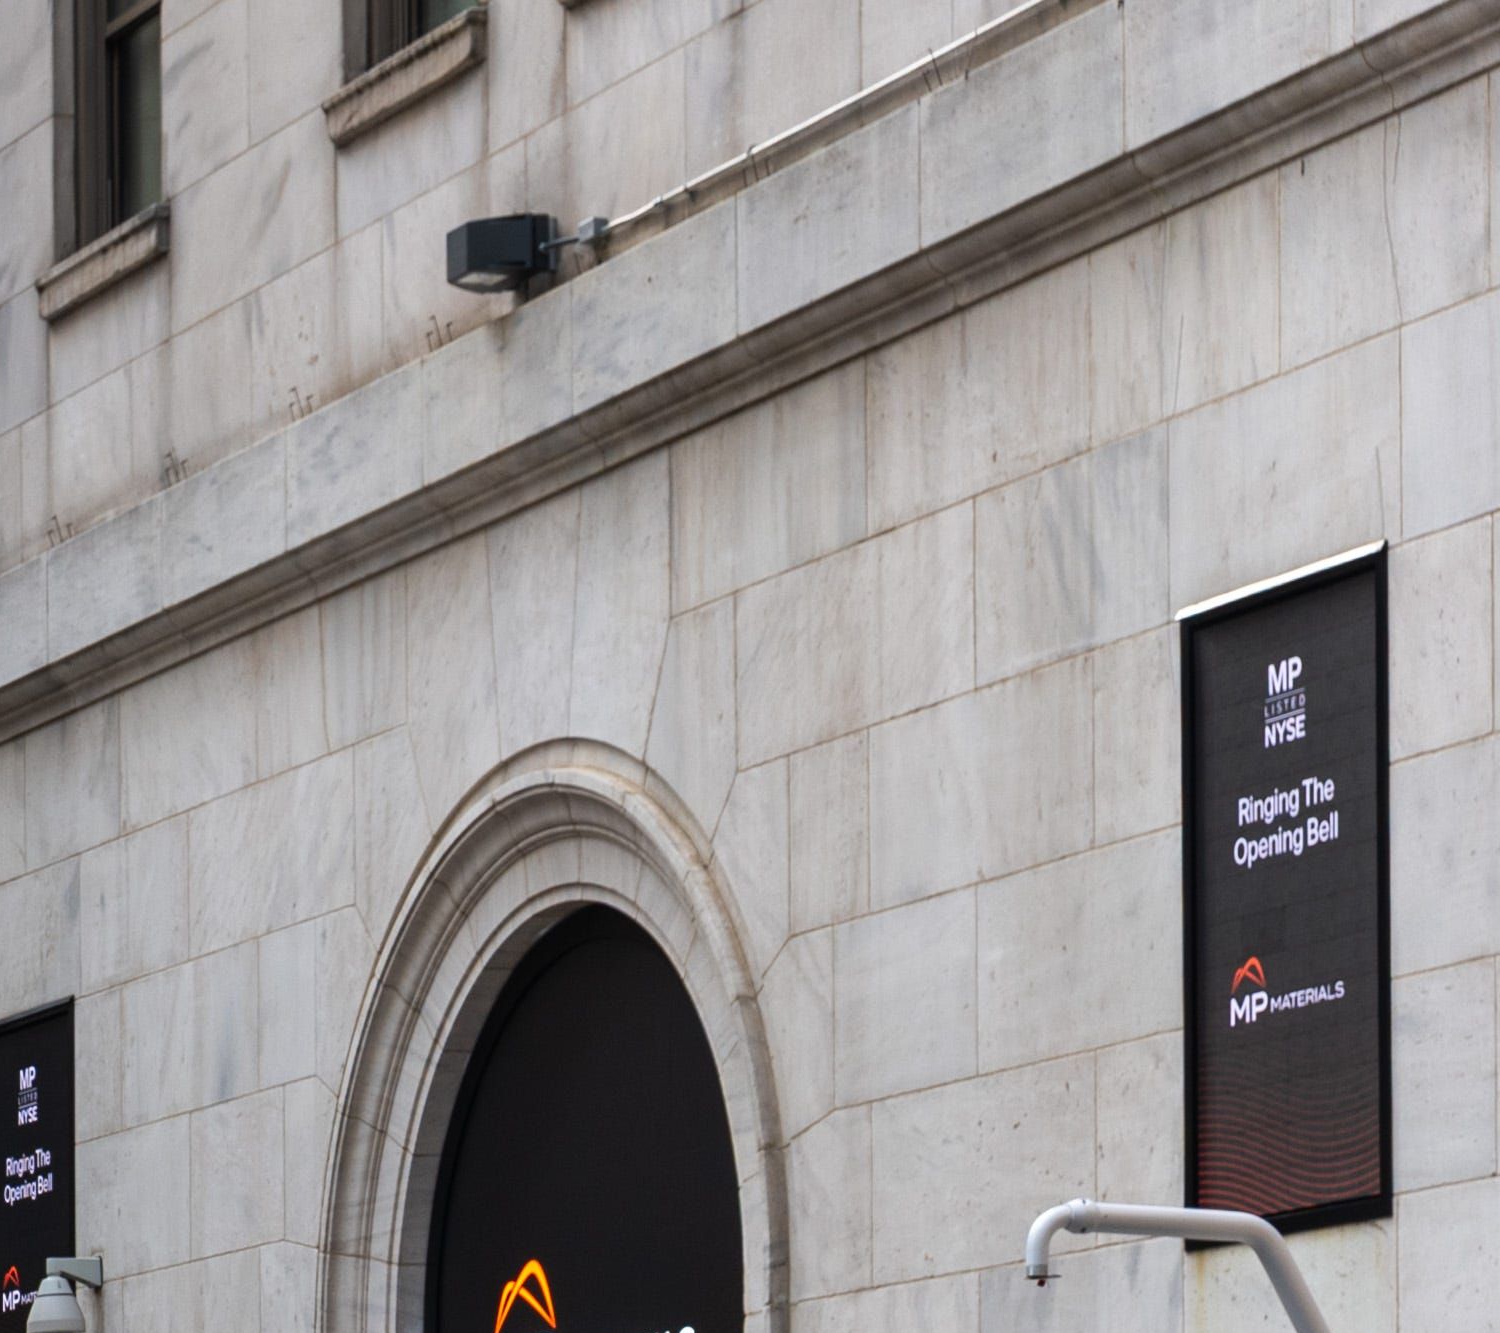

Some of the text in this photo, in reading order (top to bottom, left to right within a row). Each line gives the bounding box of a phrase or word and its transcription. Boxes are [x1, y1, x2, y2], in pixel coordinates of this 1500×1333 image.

[1267, 655, 1303, 697] MP
[1263, 692, 1307, 718] LISTED
[1263, 713, 1307, 748] NYSE
[1237, 775, 1336, 827] Ringing The
[1233, 809, 1340, 870] Opening Bell
[1229, 979, 1346, 1028] MP MATERIALS
[18, 1065, 37, 1092] MP
[17, 1105, 38, 1127] NYSE
[5, 1147, 52, 1178] Ringing The
[3, 1171, 54, 1206] Opening Bell
[2, 1289, 22, 1314] MP
